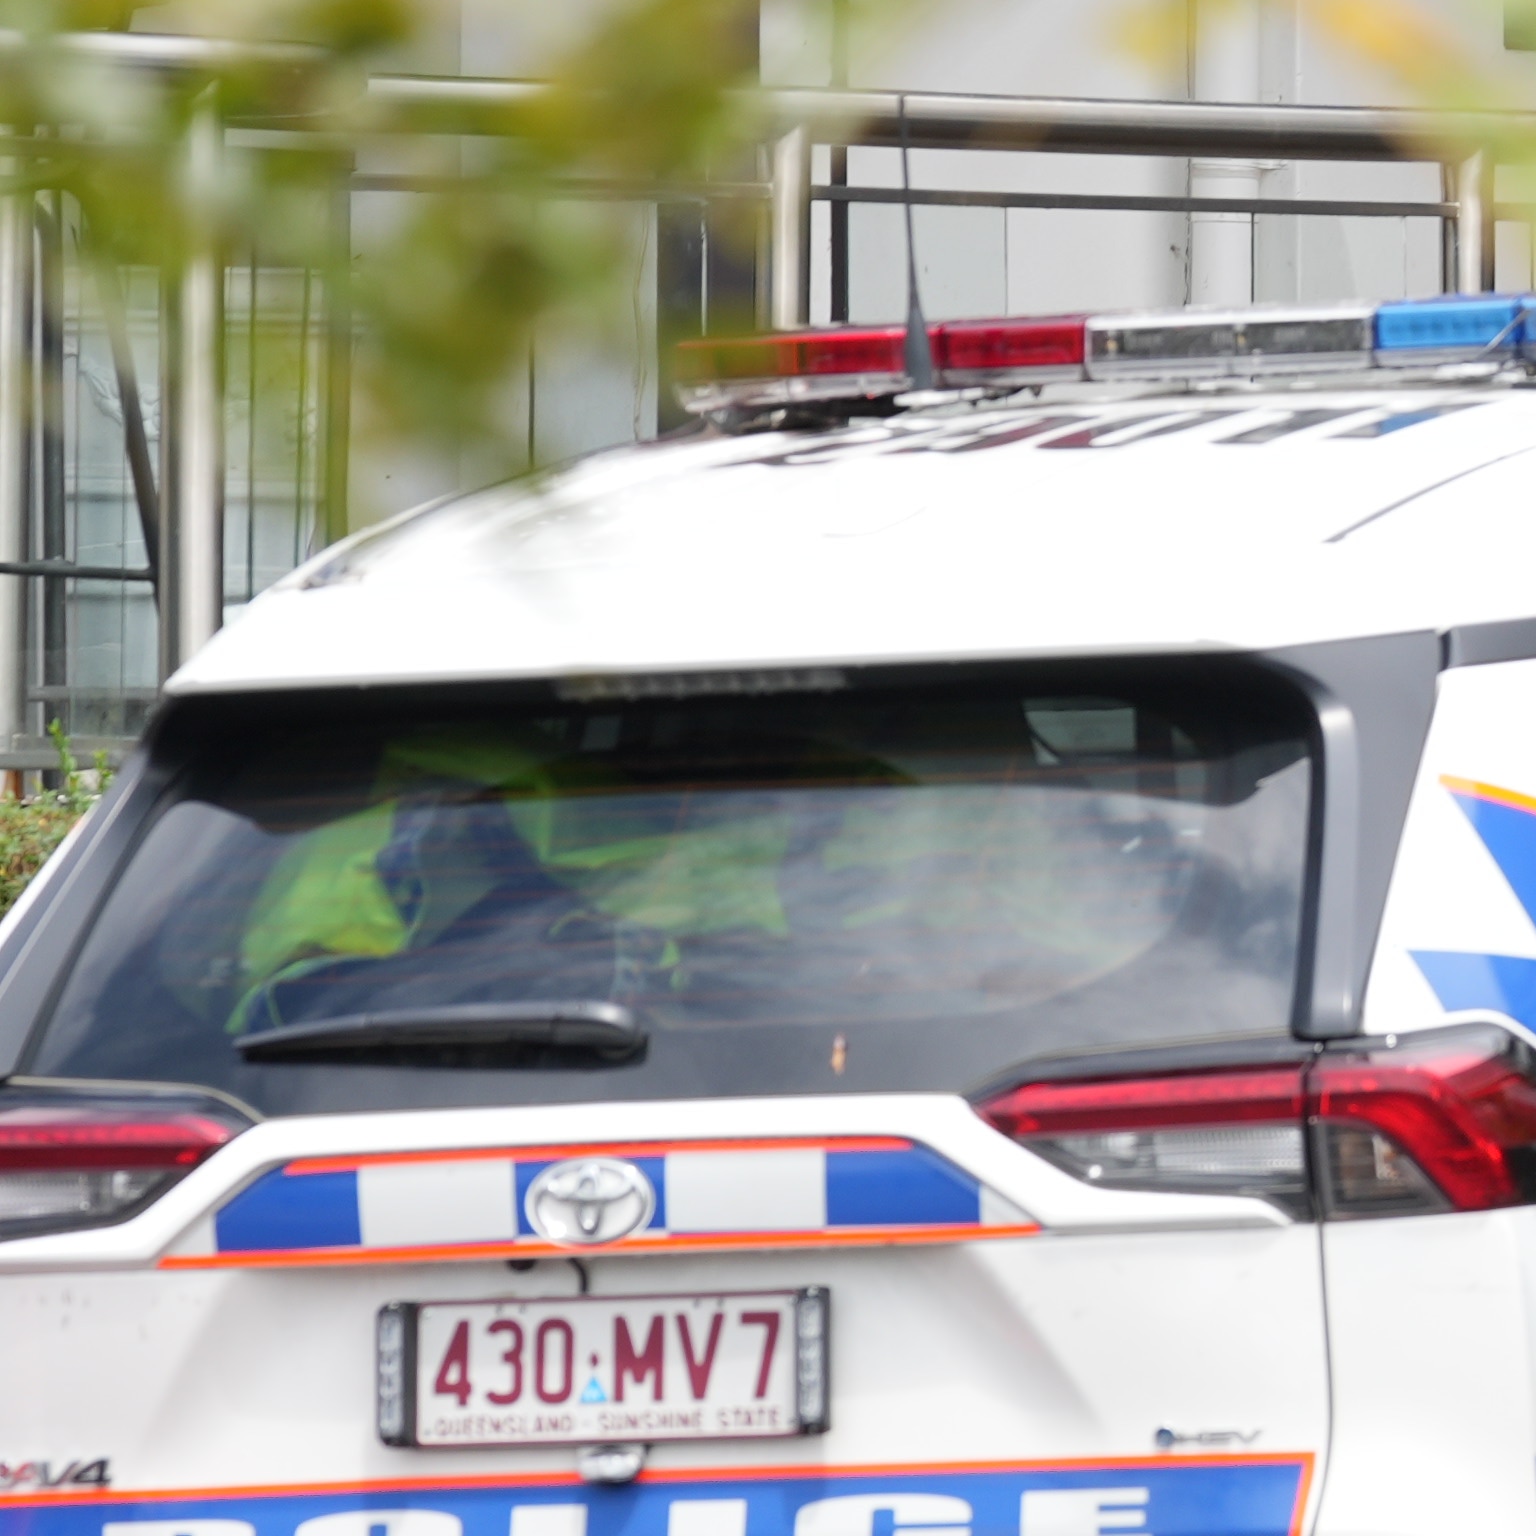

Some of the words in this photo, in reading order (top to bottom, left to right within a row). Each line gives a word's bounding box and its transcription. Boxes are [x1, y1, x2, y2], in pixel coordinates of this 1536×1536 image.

[434, 1318, 575, 1406] 430
[613, 1311, 782, 1403] MV7
[433, 1416, 575, 1438] QUEENSLAND
[597, 1410, 705, 1432] SUNSHINE
[718, 1407, 782, 1429] STATE
[100, 1486, 1151, 1536] LICE
